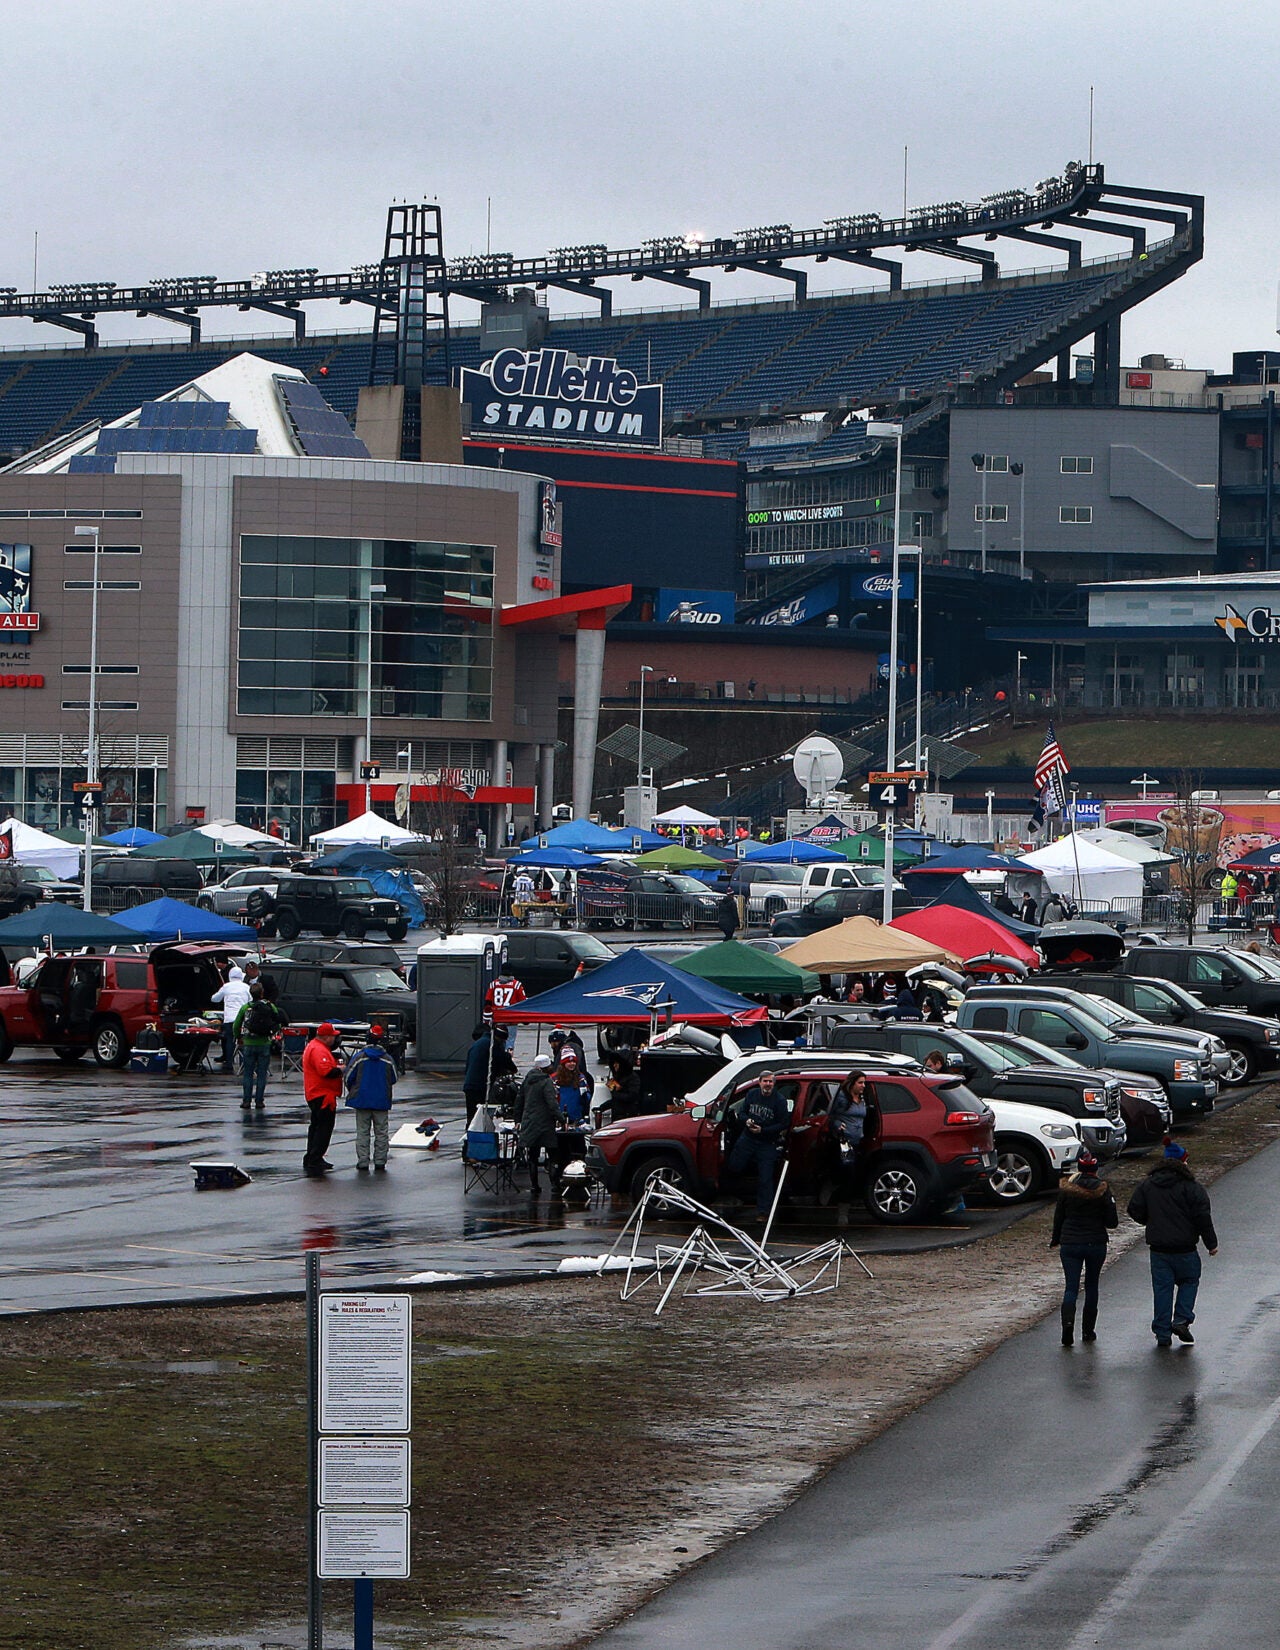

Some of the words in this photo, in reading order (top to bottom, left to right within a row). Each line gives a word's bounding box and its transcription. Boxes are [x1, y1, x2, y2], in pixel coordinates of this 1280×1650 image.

[489, 347, 638, 406] Gillette
[483, 402, 643, 436] STADIUM
[772, 511, 782, 522] TO
[783, 509, 807, 521] WATCH
[808, 507, 823, 519] LIVE
[822, 505, 844, 518] SPORTS
[768, 555, 781, 565] NEW
[1, 616, 37, 627] ALL
[0, 652, 31, 660] PLACE
[908, 779, 916, 791] 4
[81, 792, 94, 806] 4
[880, 785, 897, 804] 4
[494, 987, 514, 1007] 87
